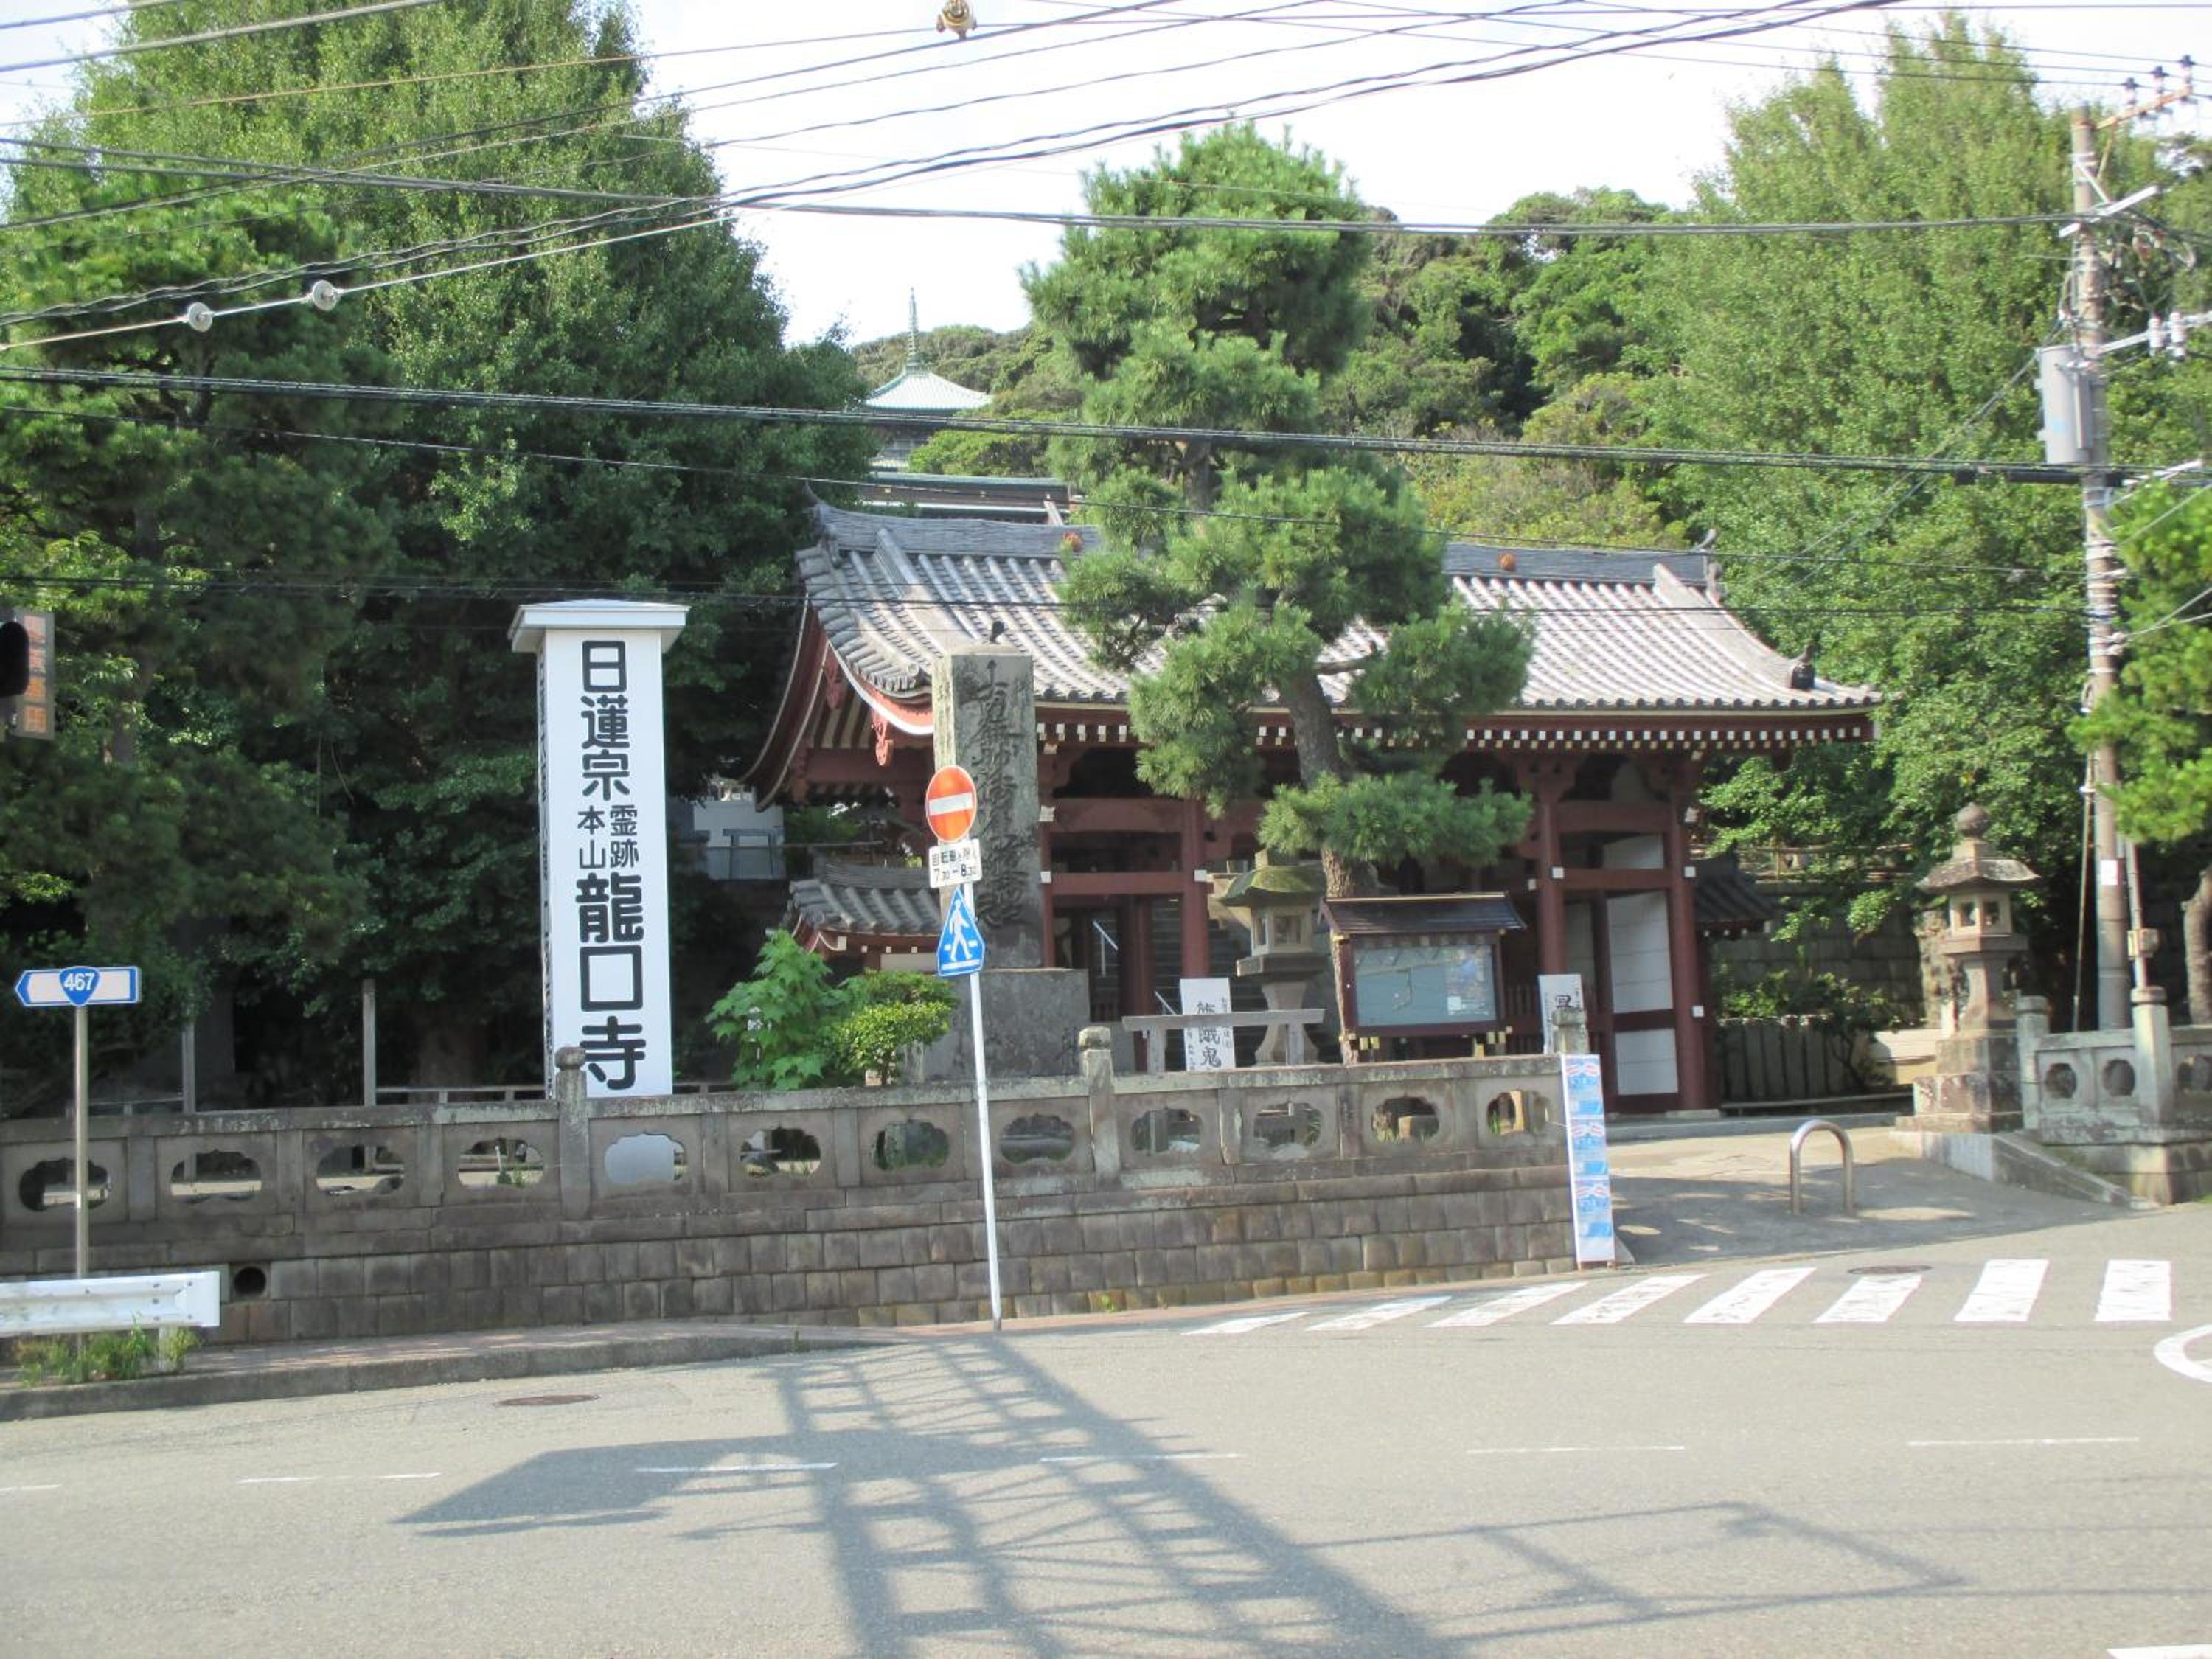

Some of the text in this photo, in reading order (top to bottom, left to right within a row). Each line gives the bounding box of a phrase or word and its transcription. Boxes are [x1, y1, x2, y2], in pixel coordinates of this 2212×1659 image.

[580, 640, 630, 801] 日蓮宗
[577, 804, 606, 870] 本山
[609, 804, 640, 869] 霊跡
[63, 972, 95, 992] 467
[574, 872, 647, 1091] 龍口寺
